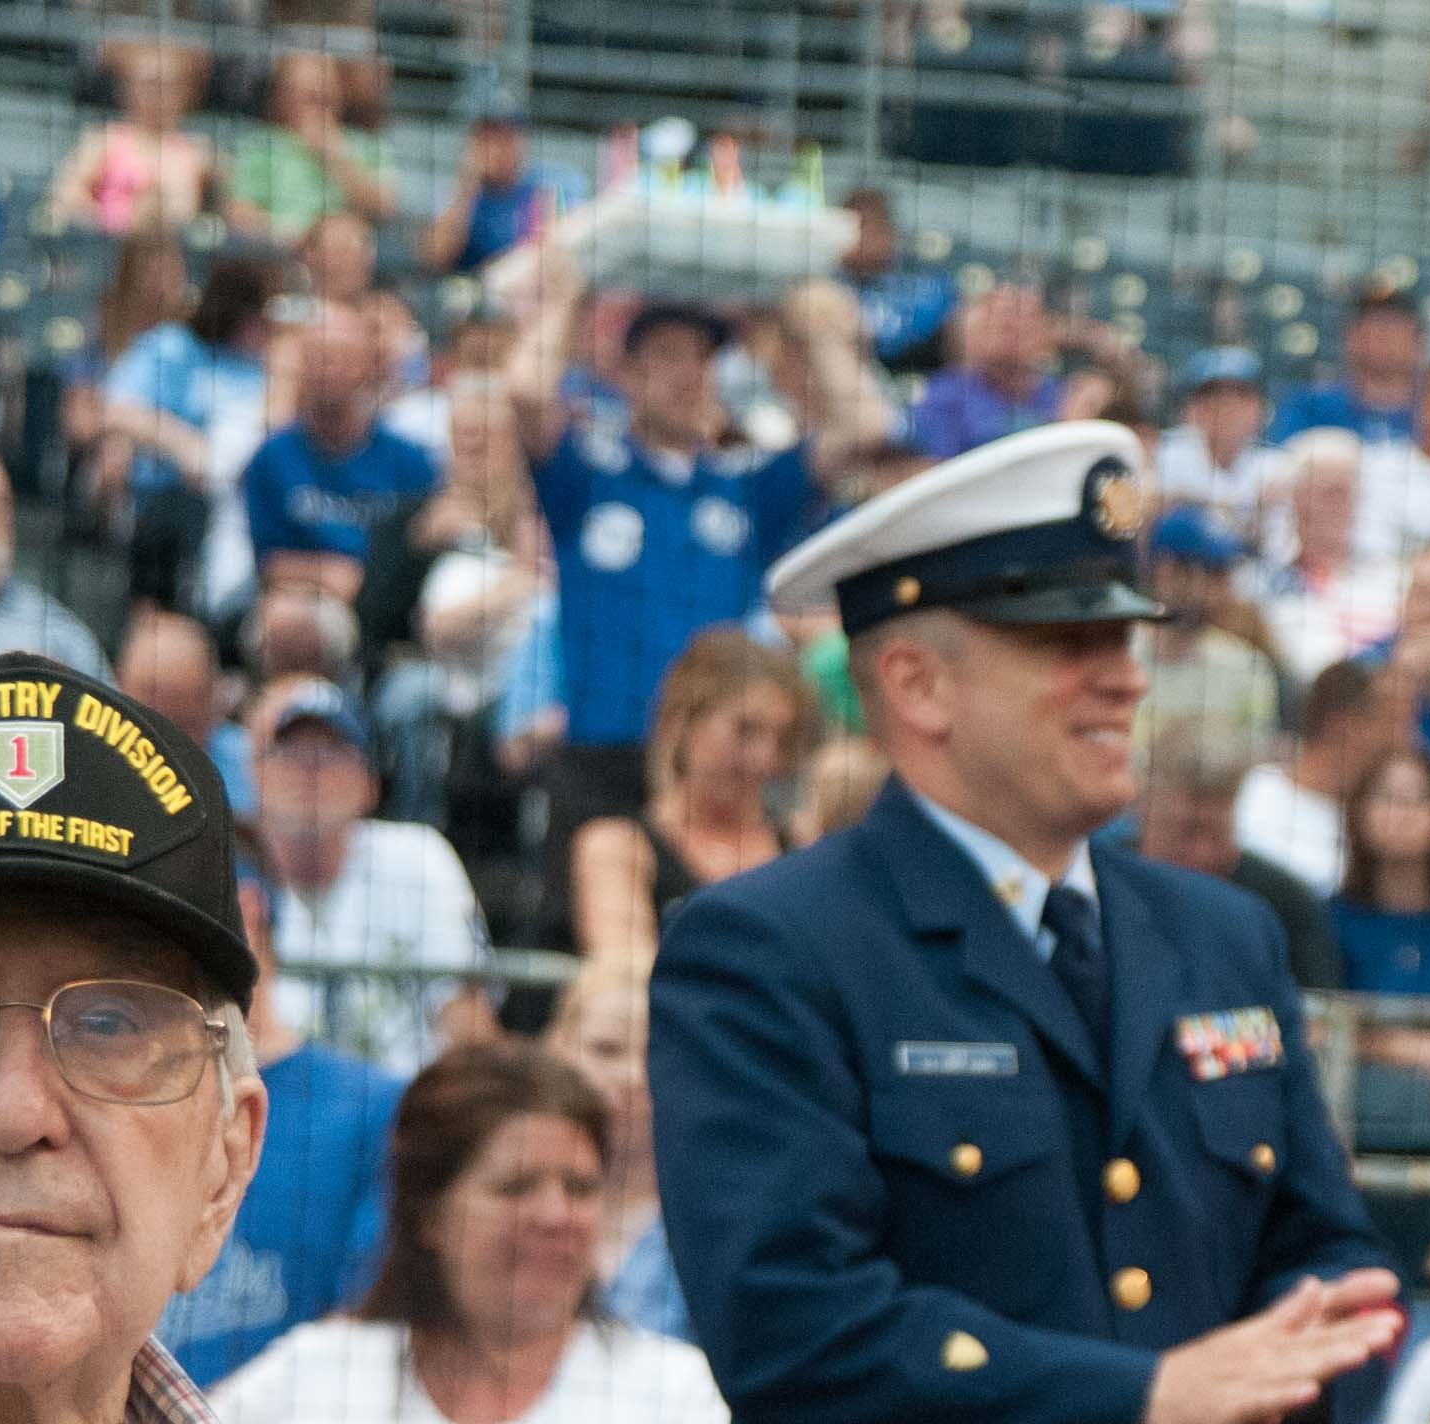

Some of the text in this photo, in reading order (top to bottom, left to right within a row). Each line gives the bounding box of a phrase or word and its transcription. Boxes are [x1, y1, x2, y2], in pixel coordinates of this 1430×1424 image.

[8, 735, 36, 779] 1
[73, 693, 193, 816] DIVISION
[16, 810, 65, 842] THE
[65, 816, 135, 857] FIRST
